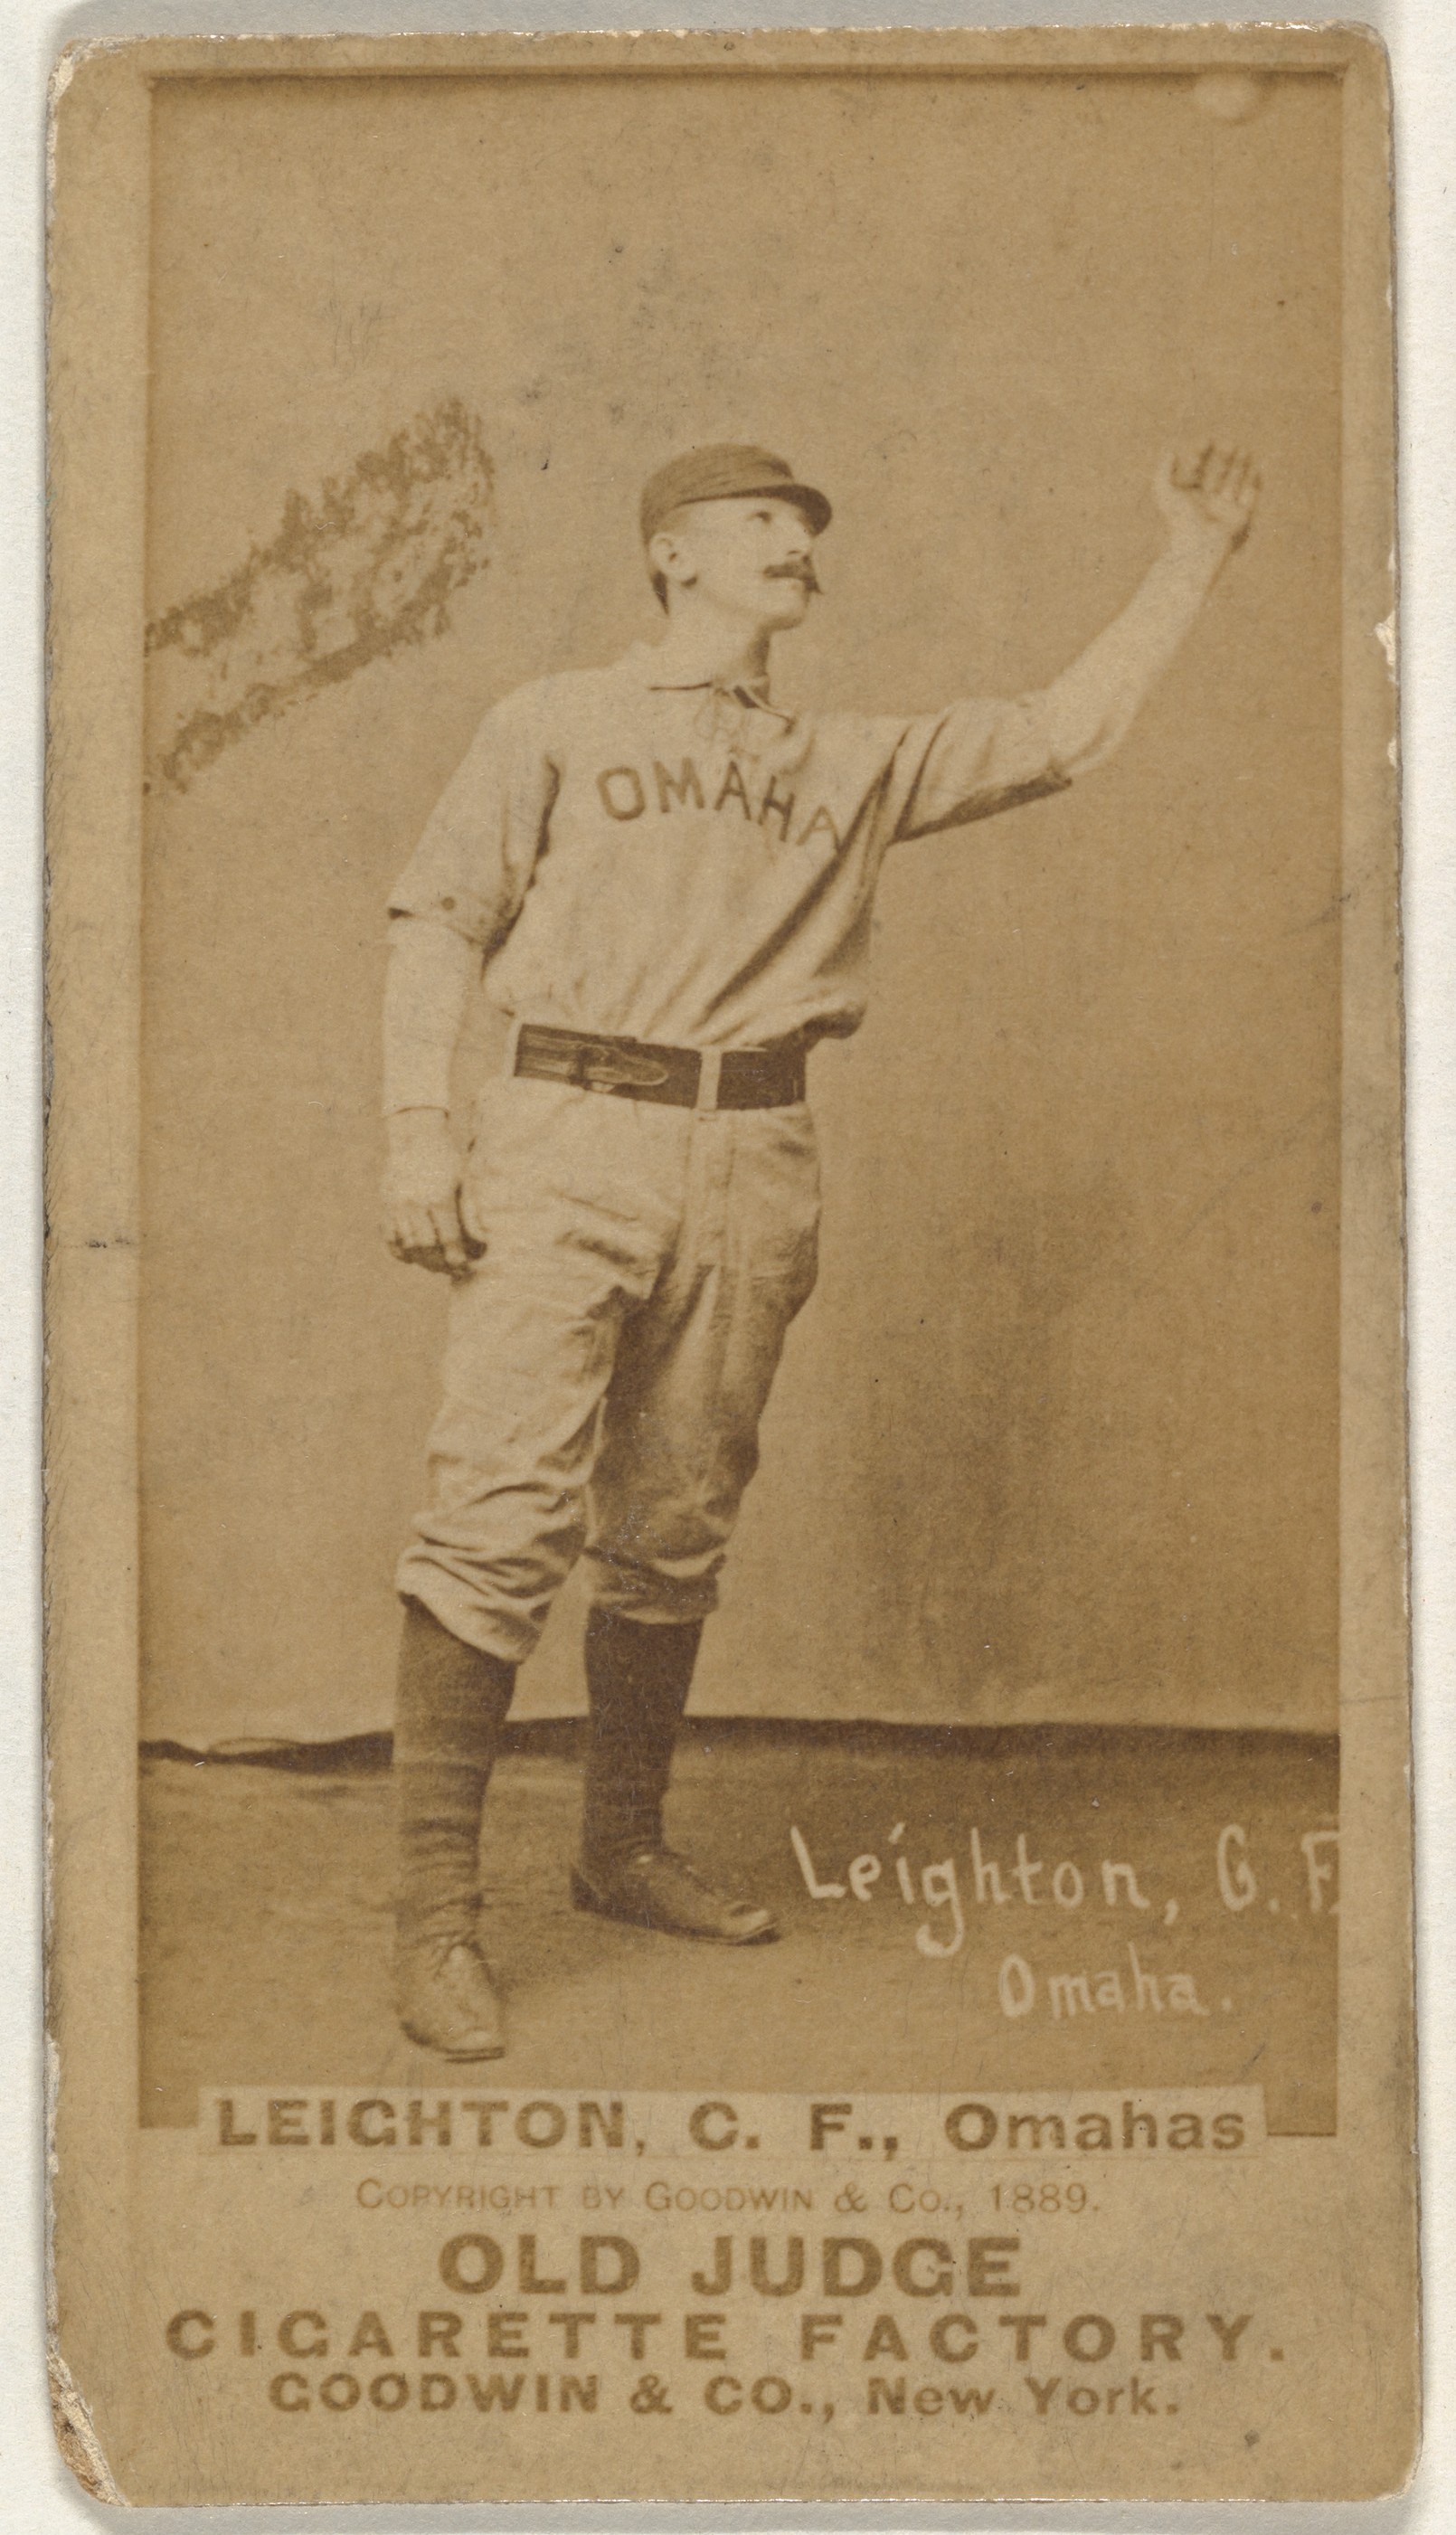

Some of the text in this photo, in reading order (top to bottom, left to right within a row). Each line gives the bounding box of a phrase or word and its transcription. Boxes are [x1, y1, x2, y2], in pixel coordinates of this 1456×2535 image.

[596, 757, 839, 847] OMAHA
[790, 1822, 1178, 1957] Leighton,
[999, 1942, 1233, 2019] Omaha.
[215, 2099, 1245, 2161] LEIGHTON, C. F., Omahas
[834, 2182, 868, 2213] &
[991, 2182, 1101, 2214] 1889.
[439, 2234, 1021, 2297] OLD JUDGE
[165, 2310, 1284, 2362] CIGARETTE FACTORY.
[270, 2372, 1179, 2423] GOODWIN & CO., New York.
